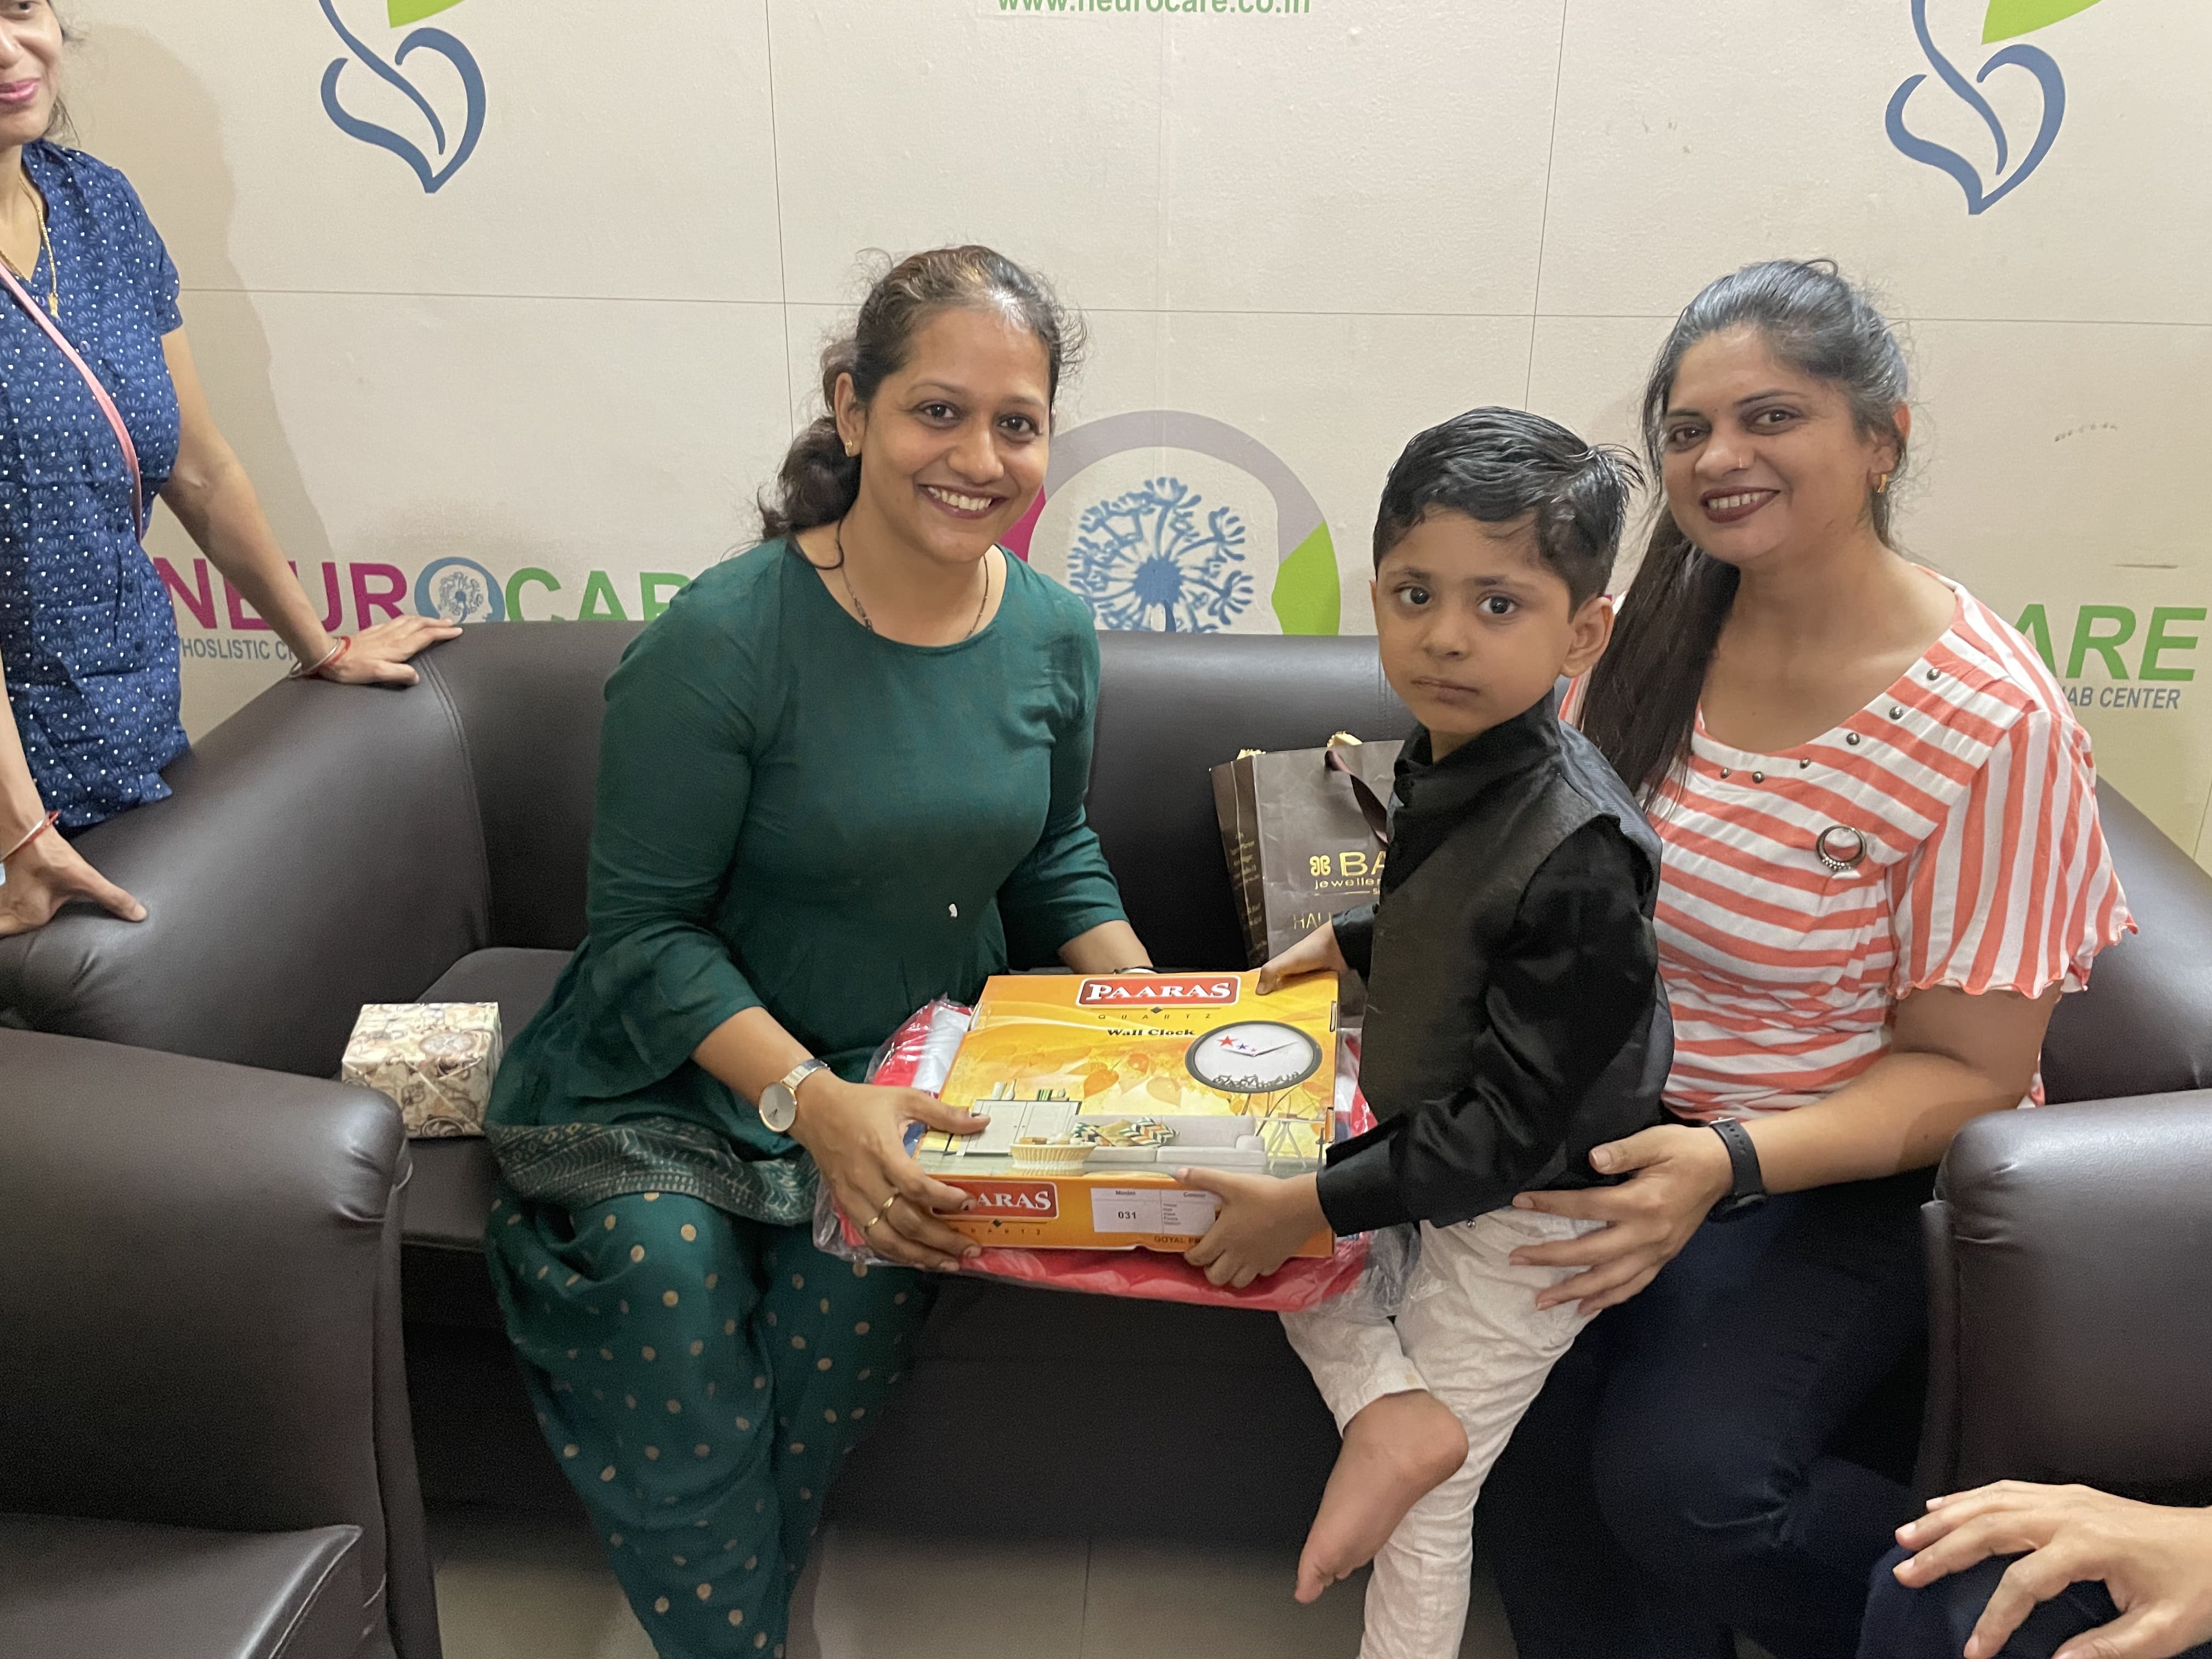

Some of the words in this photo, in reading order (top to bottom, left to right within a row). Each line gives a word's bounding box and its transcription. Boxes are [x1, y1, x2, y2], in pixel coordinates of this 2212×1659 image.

[183, 638, 270, 660] HOSLISTIC
[2062, 686, 2094, 707] AB
[2100, 687, 2181, 709] CENTER
[1085, 982, 1230, 1000] PAARAS
[978, 1190, 1052, 1210] ARAS
[1118, 1211, 1137, 1220] 031
